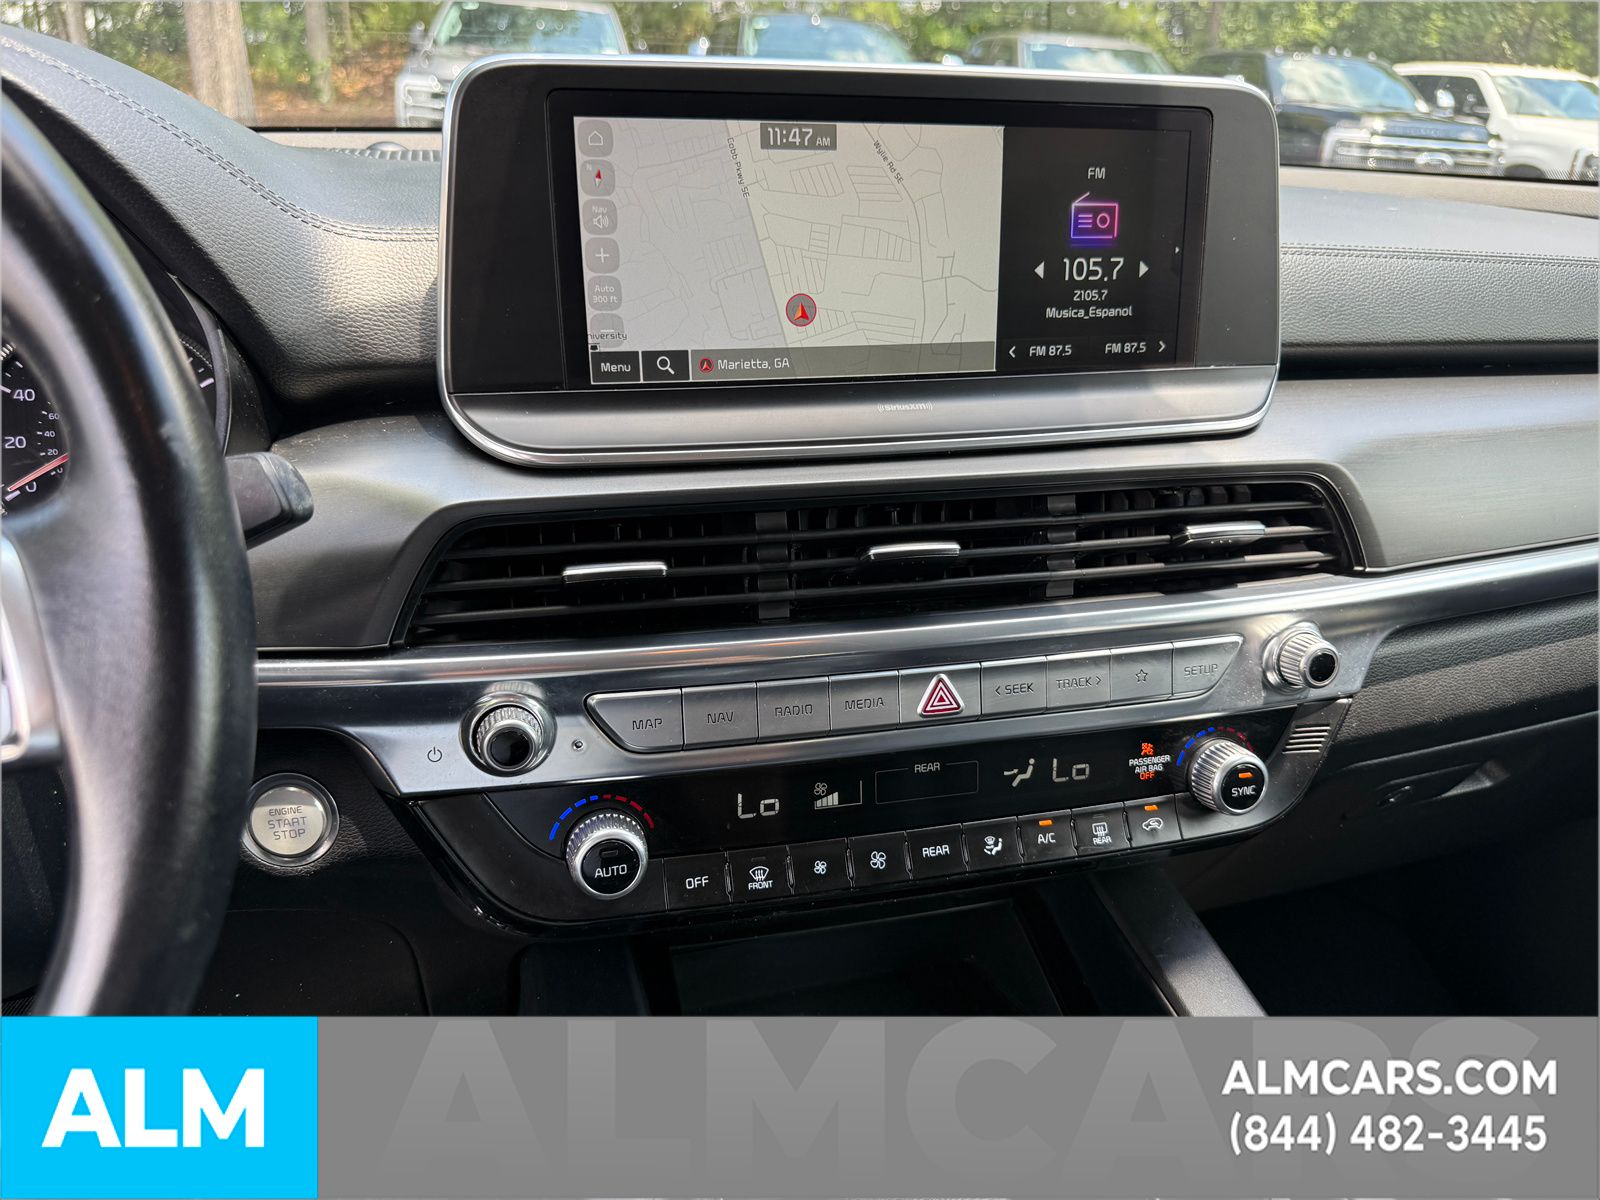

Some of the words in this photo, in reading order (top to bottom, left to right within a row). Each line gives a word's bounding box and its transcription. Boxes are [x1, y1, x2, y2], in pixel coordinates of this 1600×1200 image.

[767, 126, 814, 147] 11:47
[815, 137, 832, 147] AM
[873, 139, 889, 162] Wylie
[887, 161, 897, 174] Rd
[727, 137, 739, 161] Cobb
[735, 161, 746, 186] Pkwy
[741, 186, 751, 199] SE
[1087, 167, 1106, 180] FM
[1062, 257, 1125, 282] 105.7
[594, 284, 615, 293] Auto
[592, 295, 609, 304] 300
[610, 295, 619, 303] ft
[1045, 305, 1133, 320] Musica_Espanol
[1029, 345, 1046, 357] FM
[1048, 345, 1072, 357] 87.5
[1104, 342, 1122, 354] FM
[1123, 341, 1147, 354] 87.5
[600, 361, 632, 374] Menu
[717, 358, 771, 371] Marietta,
[774, 356, 790, 370] GA
[13, 388, 35, 401] 40
[48, 412, 60, 421] 60
[44, 430, 56, 438] 40
[4, 435, 27, 449] 20
[47, 448, 59, 456] 20
[1183, 662, 1219, 678] SETUP
[1004, 682, 1034, 696] SEEK
[1056, 676, 1092, 690] TRACK
[774, 703, 813, 718] RADIO
[844, 696, 885, 712] MEDIA
[631, 717, 663, 732] MAP
[706, 711, 735, 725] NAV
[1128, 754, 1171, 767] PASSENGER
[914, 761, 941, 774] REAR
[1134, 765, 1147, 774] AIR
[1148, 763, 1164, 772] BAG
[1139, 771, 1155, 780] OFF
[1231, 785, 1256, 797] SYNC
[268, 805, 303, 816] ENGINE
[267, 816, 307, 830] START
[273, 828, 306, 840] STOP
[1037, 832, 1056, 845] A/C
[1092, 835, 1112, 845] REAR
[922, 844, 950, 858] REAR
[594, 863, 628, 878] AUTO
[685, 875, 709, 890] OFF
[748, 879, 773, 890] FRONT
